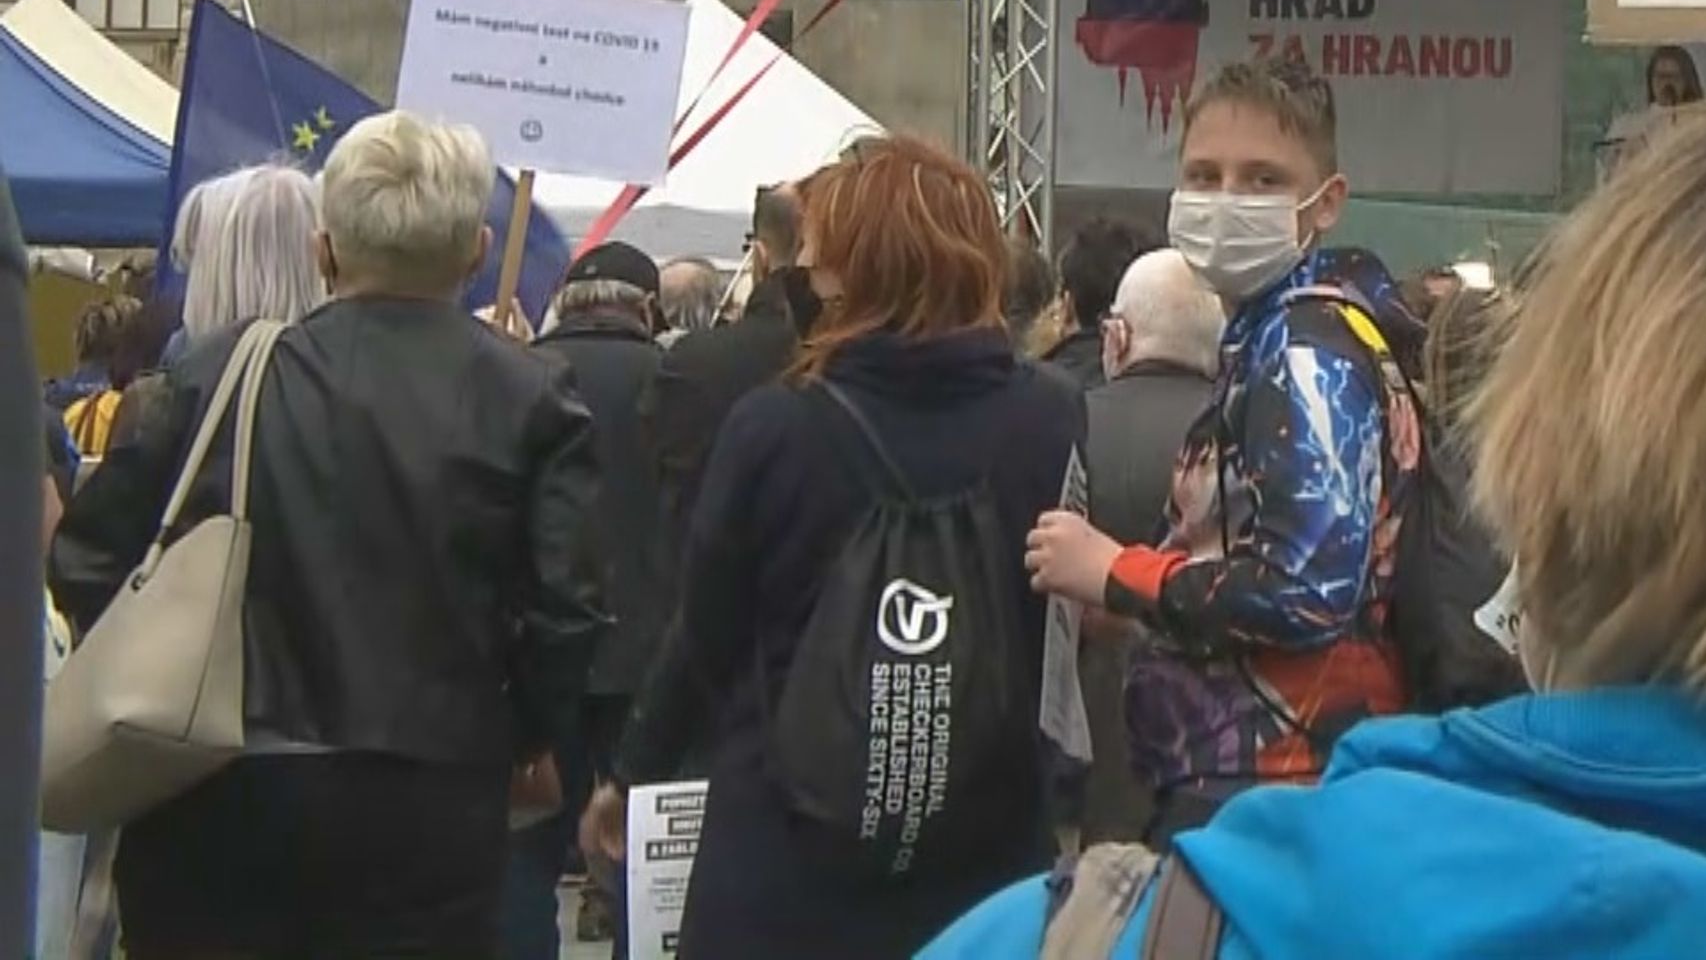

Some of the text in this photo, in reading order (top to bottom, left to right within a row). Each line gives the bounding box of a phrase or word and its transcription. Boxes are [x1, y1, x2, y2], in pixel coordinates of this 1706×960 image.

[543, 24, 570, 40] test
[594, 31, 639, 50] COVID
[642, 40, 660, 53] 19
[1248, 33, 1514, 78] ZA HRANOU
[859, 663, 891, 840] SINCE SIXTY-SIX
[885, 663, 911, 816] ESTABLISHED
[900, 664, 931, 844] CHECKERBOARD
[925, 663, 951, 818] THE ORIGINAL
